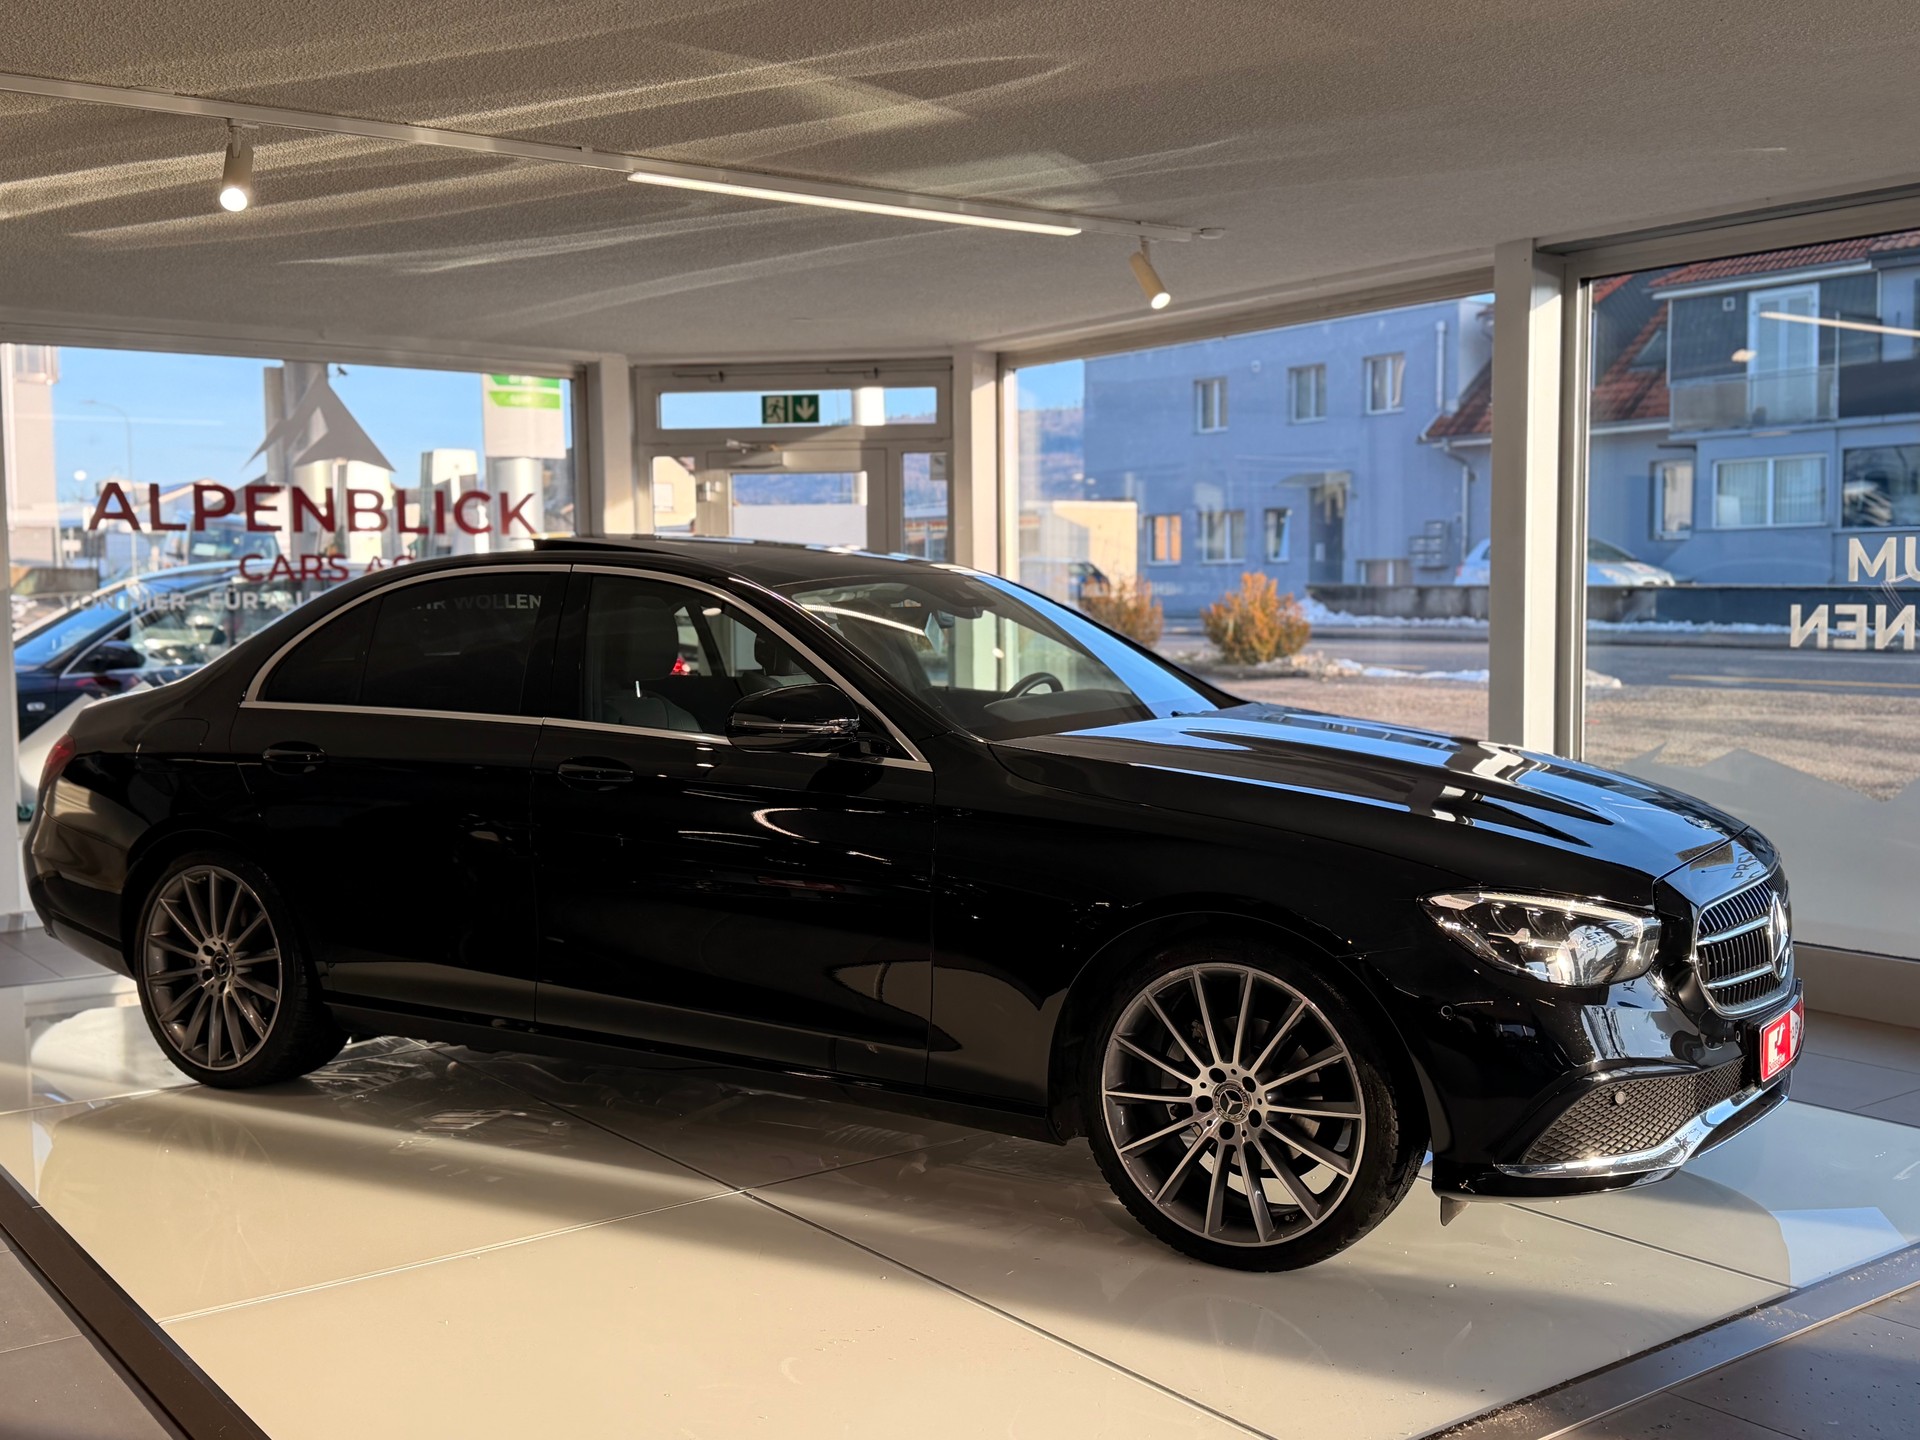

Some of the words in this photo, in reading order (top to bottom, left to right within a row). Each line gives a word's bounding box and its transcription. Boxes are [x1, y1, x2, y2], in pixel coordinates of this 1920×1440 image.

[88, 482, 537, 535] ALPENBLICK
[239, 554, 349, 582] CARS
[208, 588, 259, 612] FÜR
